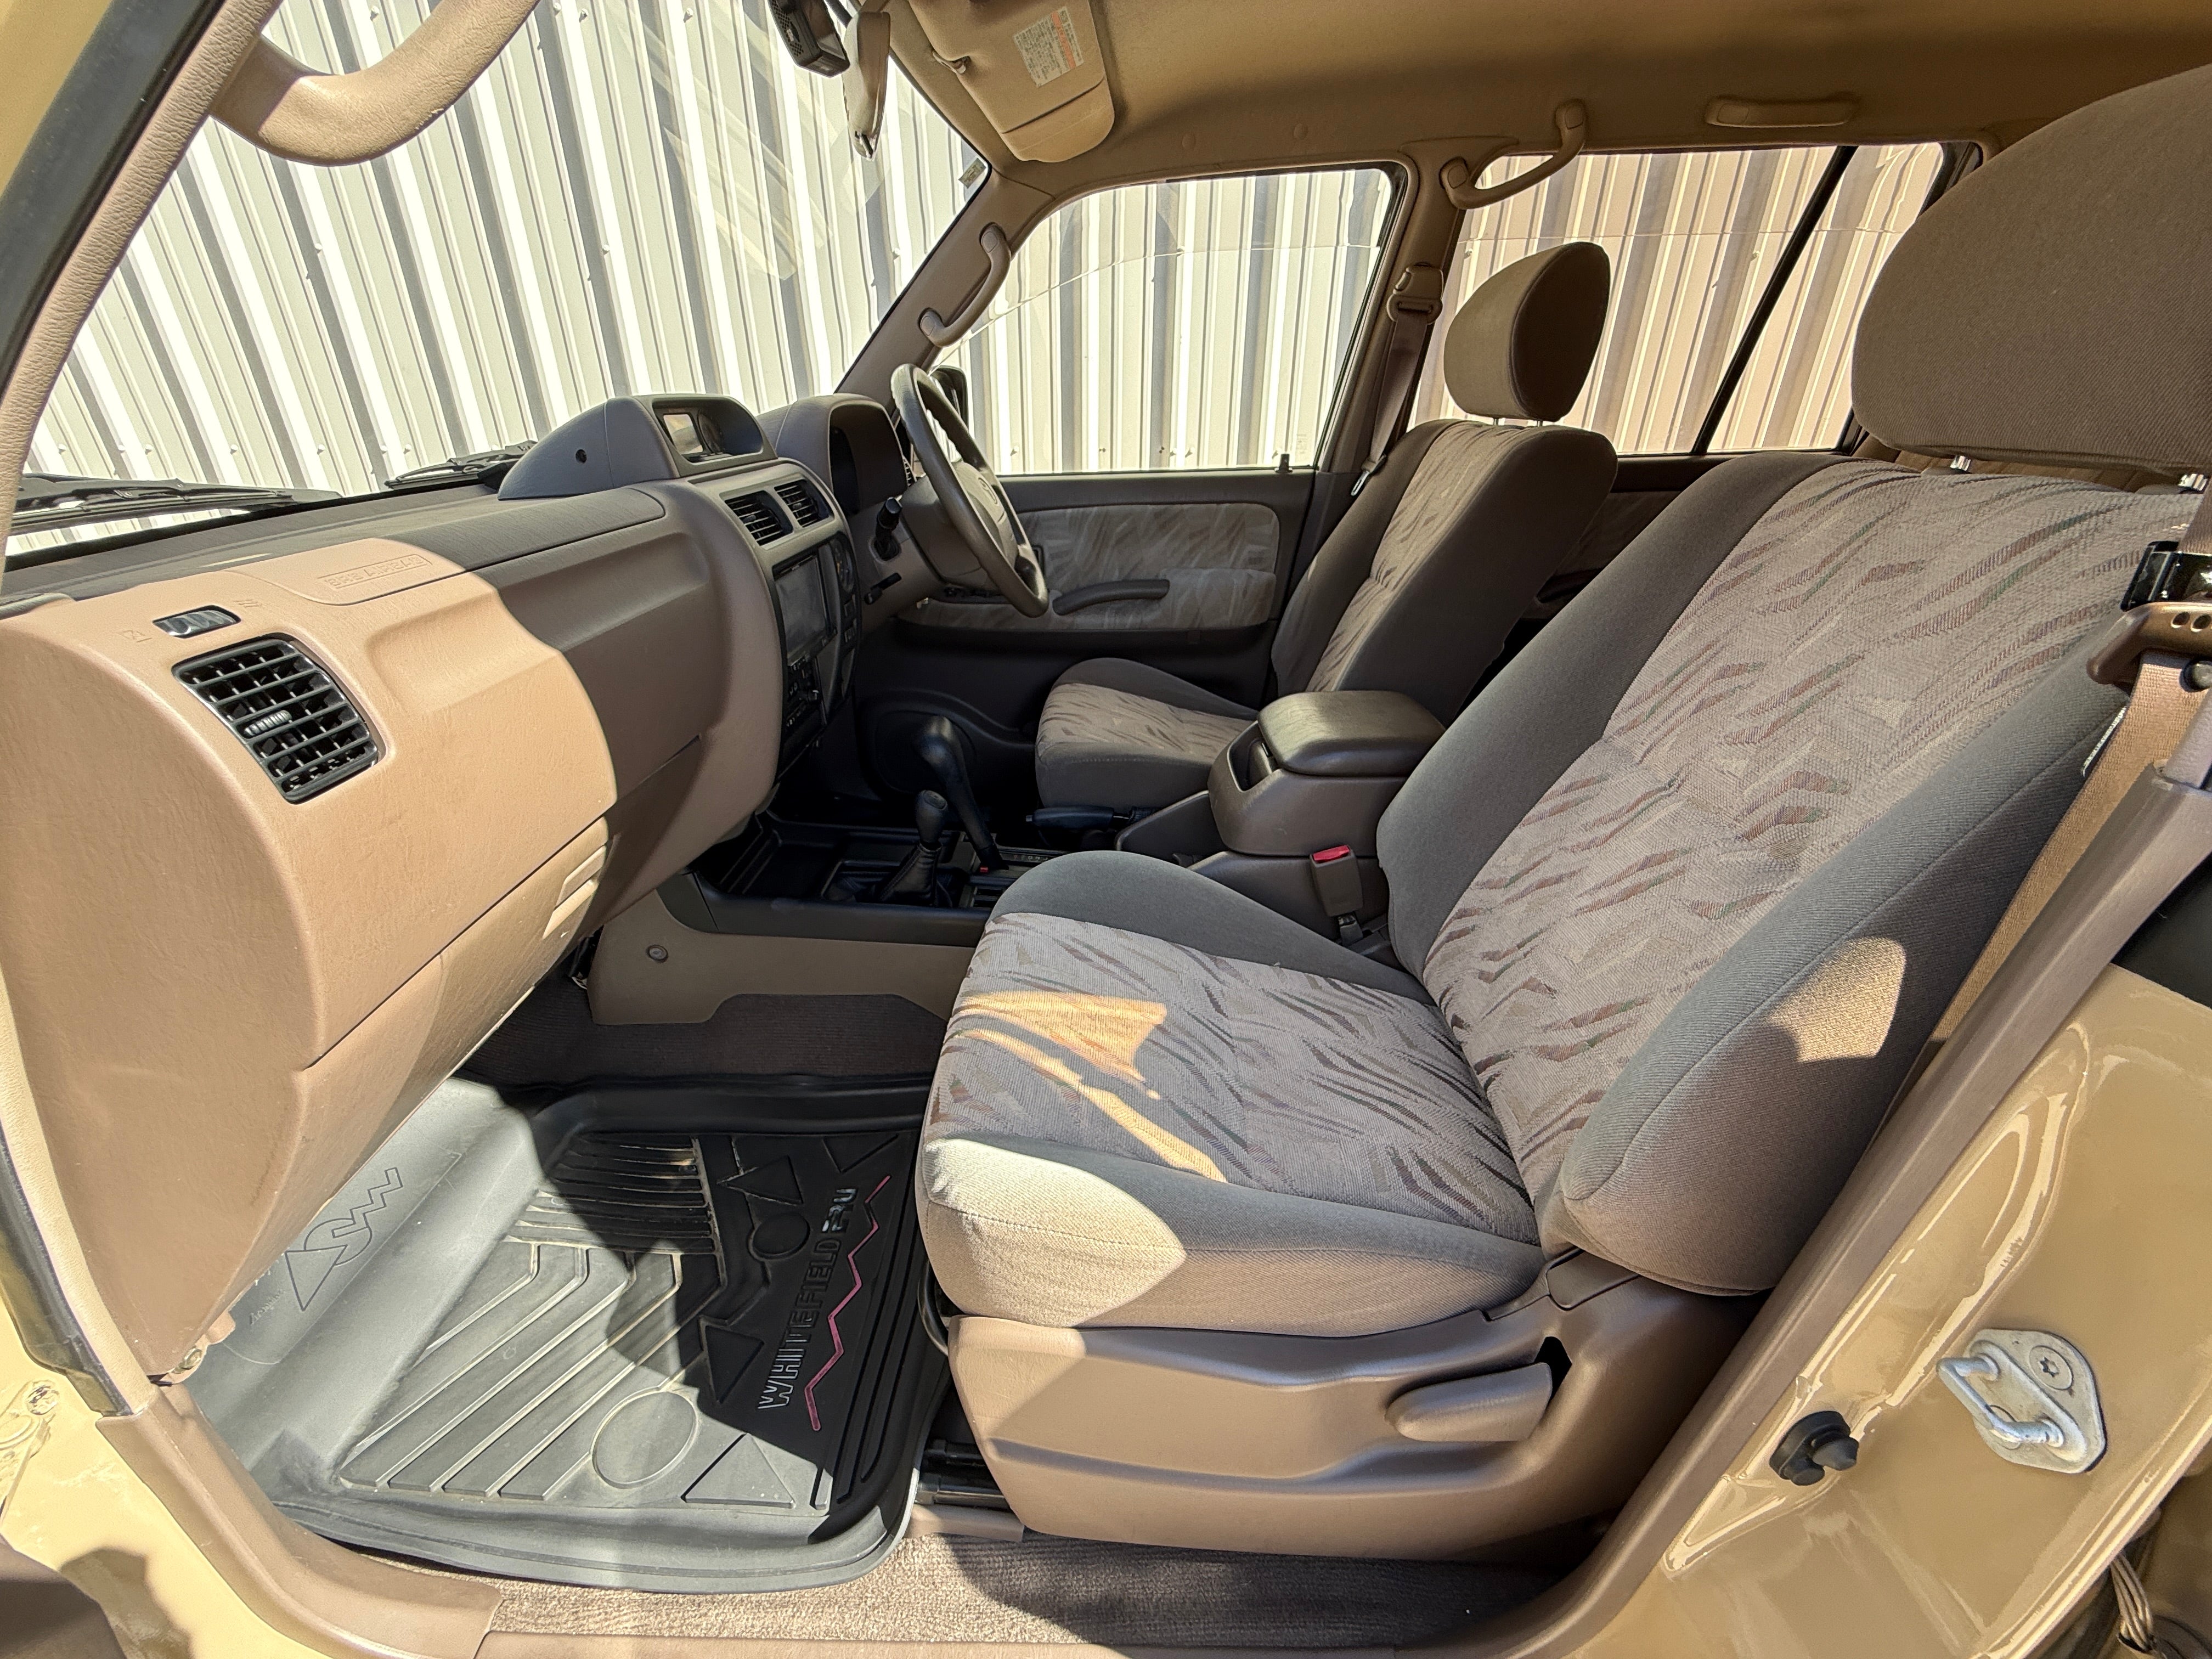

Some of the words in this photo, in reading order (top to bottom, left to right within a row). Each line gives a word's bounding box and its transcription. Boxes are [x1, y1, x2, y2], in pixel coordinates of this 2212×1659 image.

[325, 572, 362, 587] SRS
[364, 556, 424, 577] AIRBAG
[758, 1239, 842, 1409] WHITEFIELD
